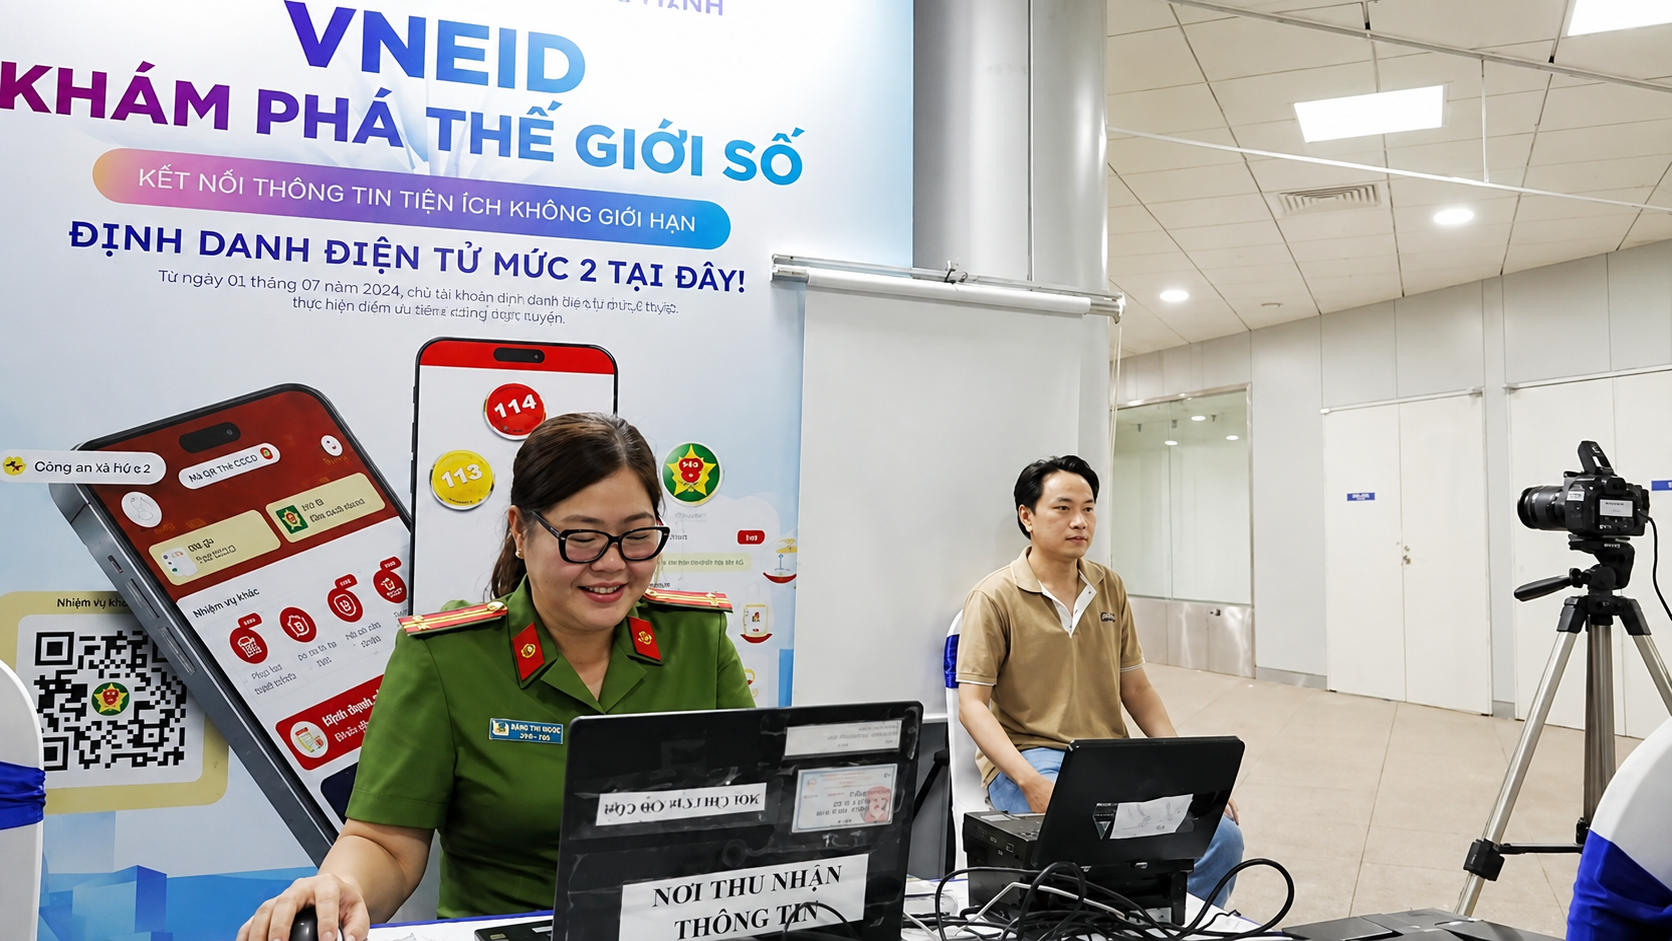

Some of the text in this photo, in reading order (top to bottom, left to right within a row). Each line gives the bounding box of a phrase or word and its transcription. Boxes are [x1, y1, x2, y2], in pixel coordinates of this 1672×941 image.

[284, 1, 586, 94] VNEID
[0, 61, 806, 186] KHÁM PHÁ THẾ GIỚI SỐ
[138, 164, 696, 235] KẾT NỐI THÔNG TIN TIỆN ÍCH KHÔNG GIỚI HẠN
[69, 221, 745, 294] ĐỊNH DANH ĐIỆN TỬ MỨC 2 TẠI ĐÂY!
[158, 269, 179, 283] Từ
[228, 274, 246, 288] 01
[251, 276, 297, 293] tháng
[302, 279, 321, 291] 07
[363, 283, 404, 299] 2024,
[293, 297, 322, 312] thực
[494, 394, 537, 419] 114
[76, 464, 92, 473] an
[440, 463, 483, 488] 113
[652, 864, 843, 907] NƠI THU NHẬN
[674, 901, 819, 940] THÔNG TIN
